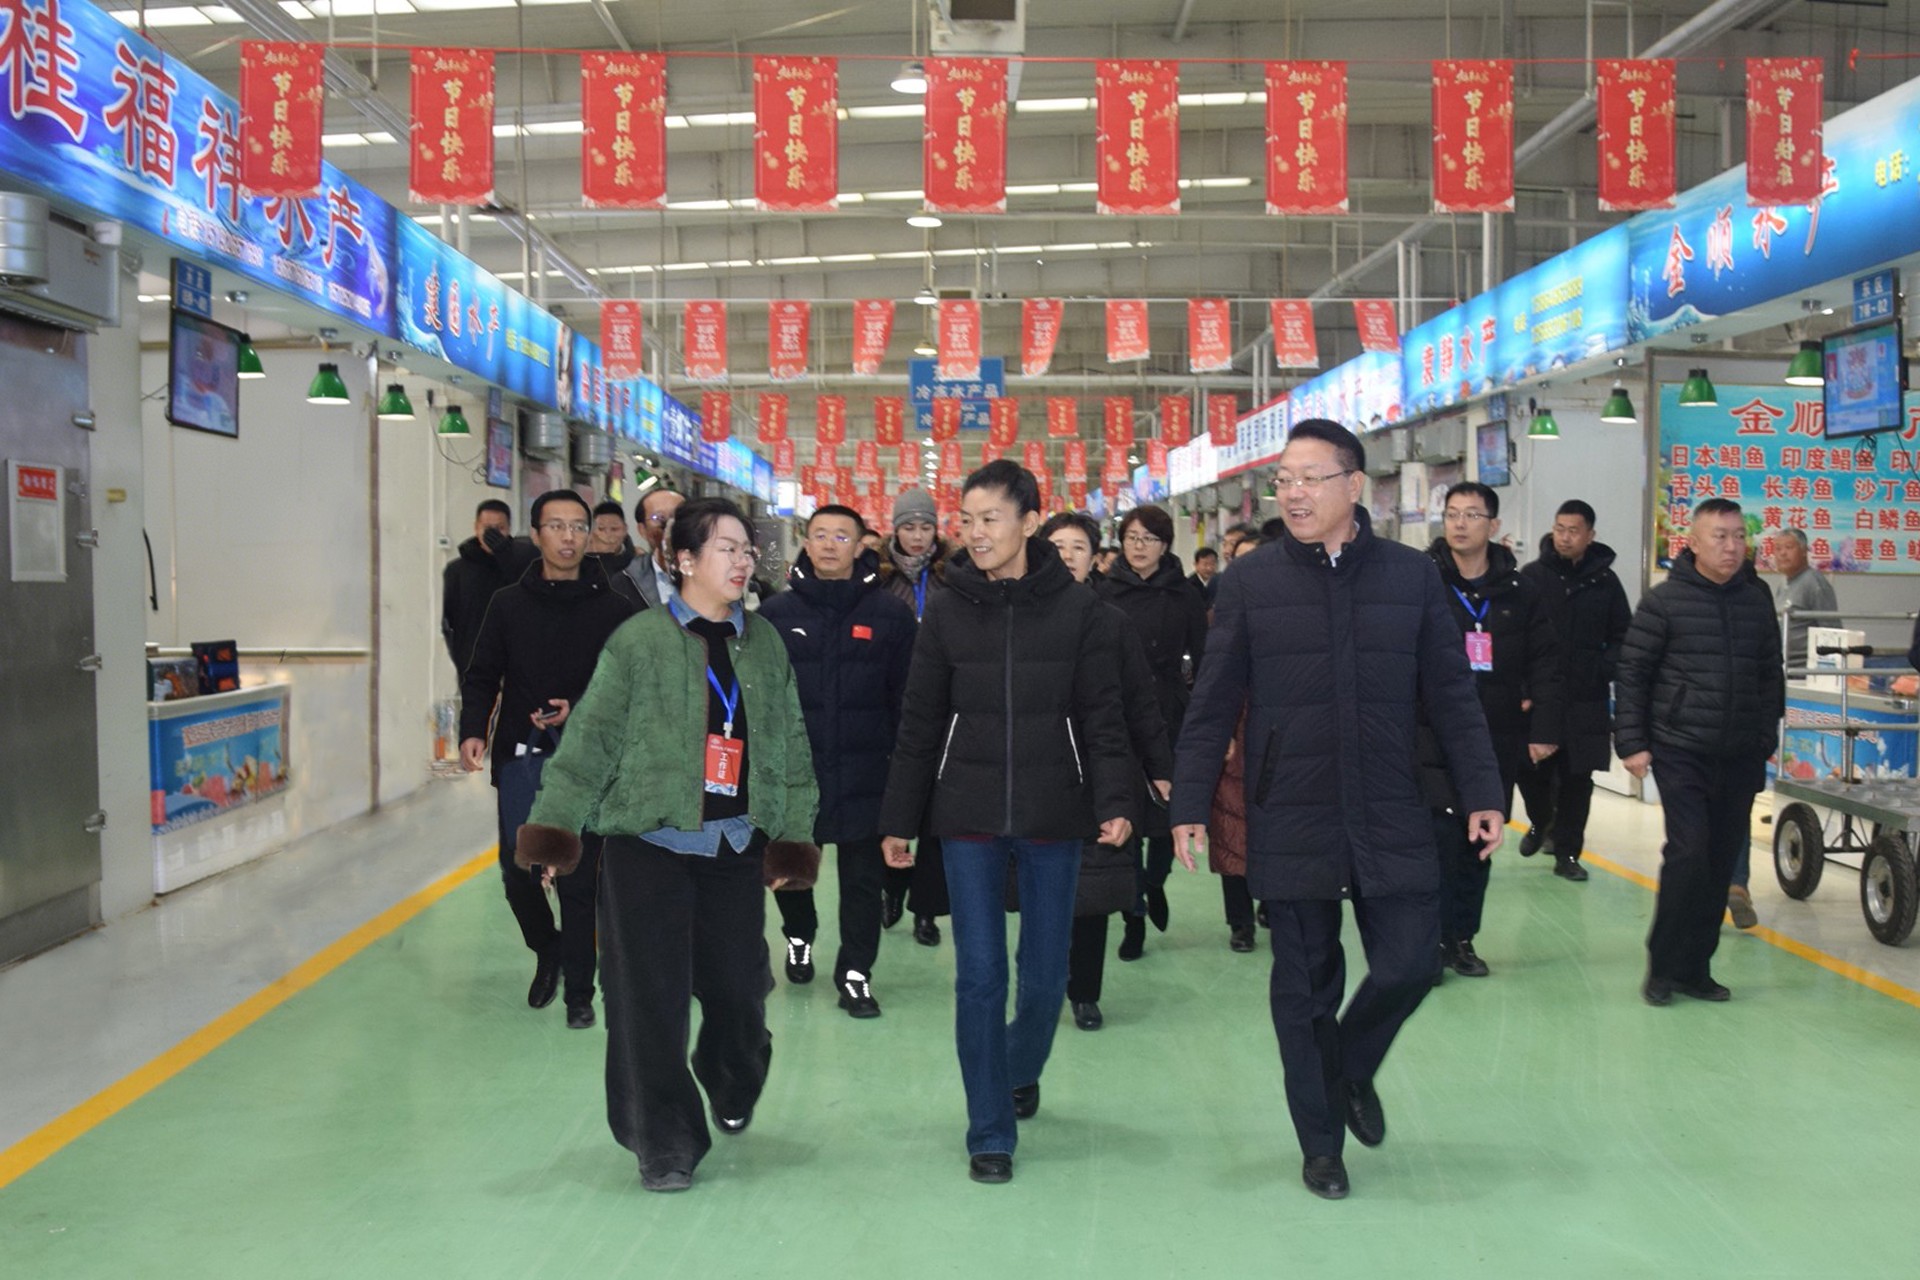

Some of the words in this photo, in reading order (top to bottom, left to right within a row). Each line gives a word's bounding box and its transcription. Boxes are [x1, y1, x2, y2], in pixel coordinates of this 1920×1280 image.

[268, 71, 294, 176] 节日快乐
[438, 78, 466, 183] 节日快乐
[610, 82, 638, 187] 节日快乐
[780, 86, 810, 191] 节日快乐
[951, 86, 979, 191] 节日快乐
[1124, 90, 1151, 194] 节日快乐
[1293, 90, 1320, 193] 节日快乐
[1460, 89, 1487, 191] 节日快乐
[1623, 87, 1650, 188] 节日快乐
[1671, 445, 1766, 469] 日本鲳鱼
[1781, 447, 1876, 472] 印度鲳鱼
[1890, 449, 1920, 473] 印
[1671, 475, 1741, 499] 舌头鱼
[1762, 476, 1834, 501] 长寿鱼
[1763, 506, 1832, 530] 黄花鱼
[1855, 538, 1897, 561] 墨鱼
